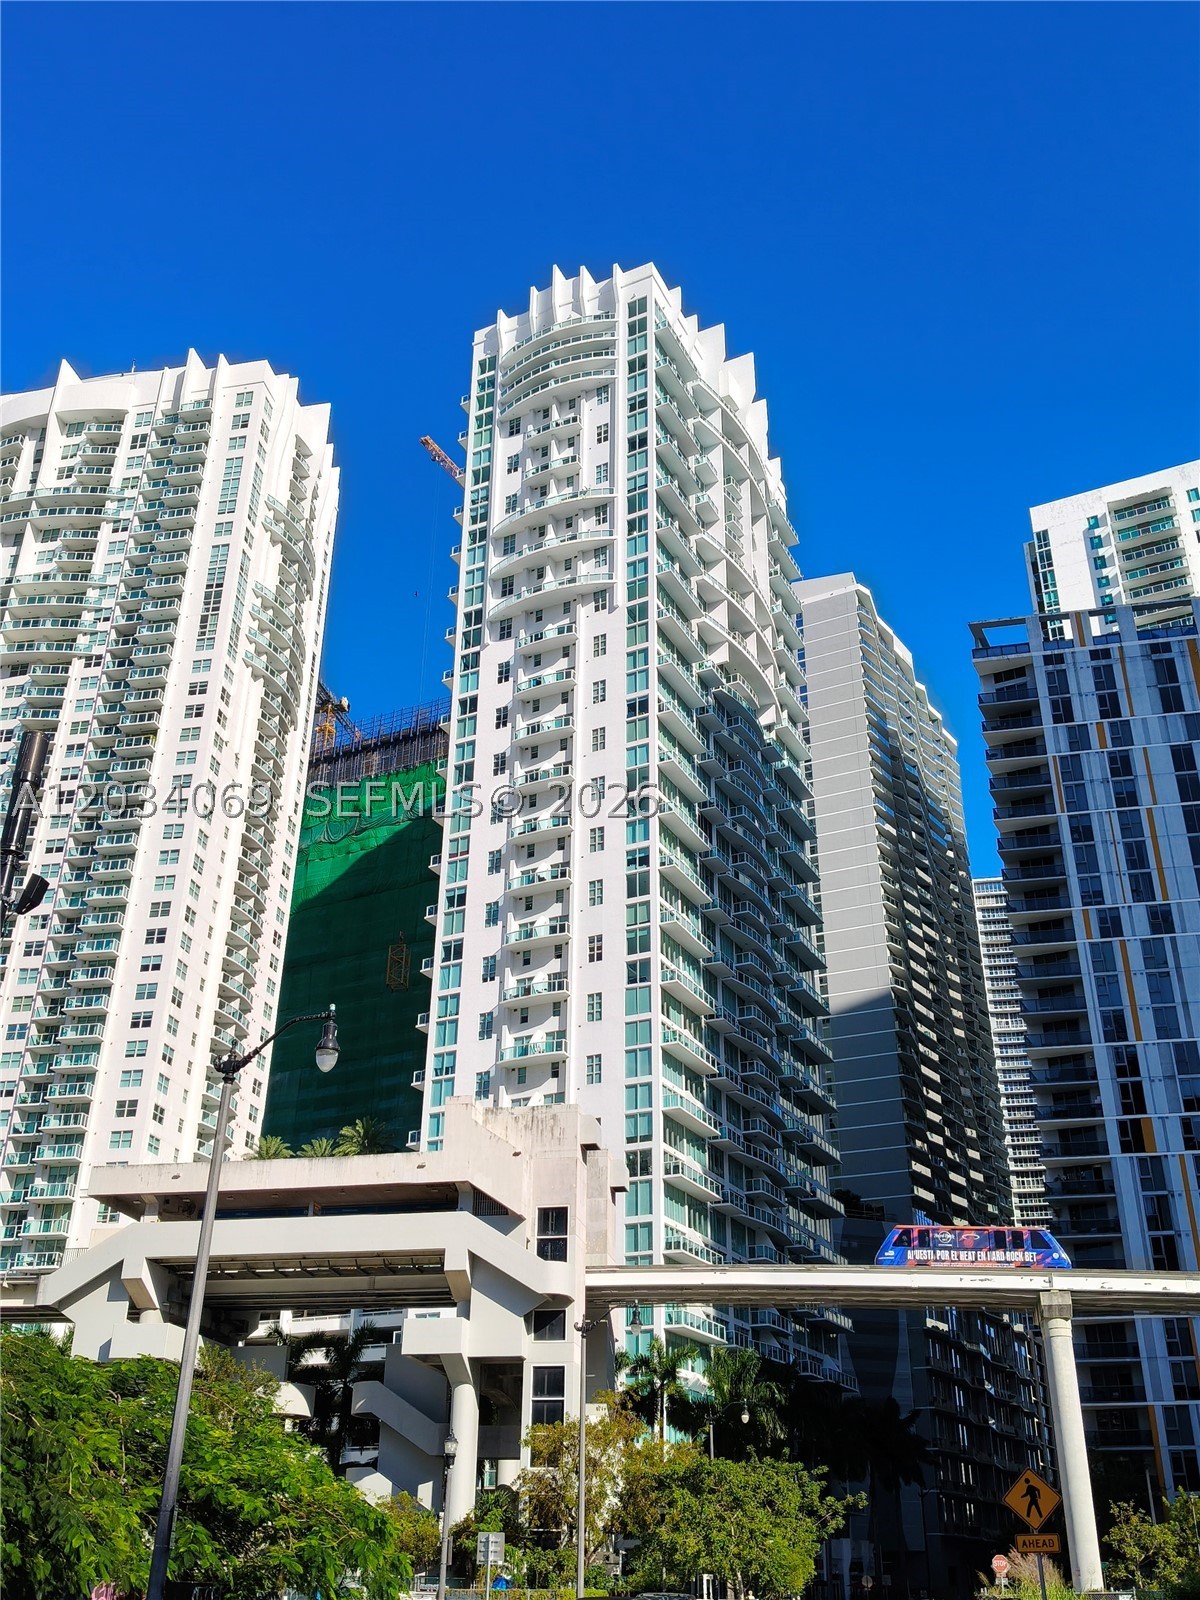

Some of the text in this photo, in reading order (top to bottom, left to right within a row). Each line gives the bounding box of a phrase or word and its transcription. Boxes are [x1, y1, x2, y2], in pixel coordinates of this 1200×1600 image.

[936, 1250, 950, 1260] POR
[951, 1251, 958, 1260] EL
[960, 1251, 976, 1260] HEAT
[977, 1251, 987, 1261] EN
[1006, 1251, 1024, 1261] ROCK
[1022, 1539, 1055, 1548] AHEAD
